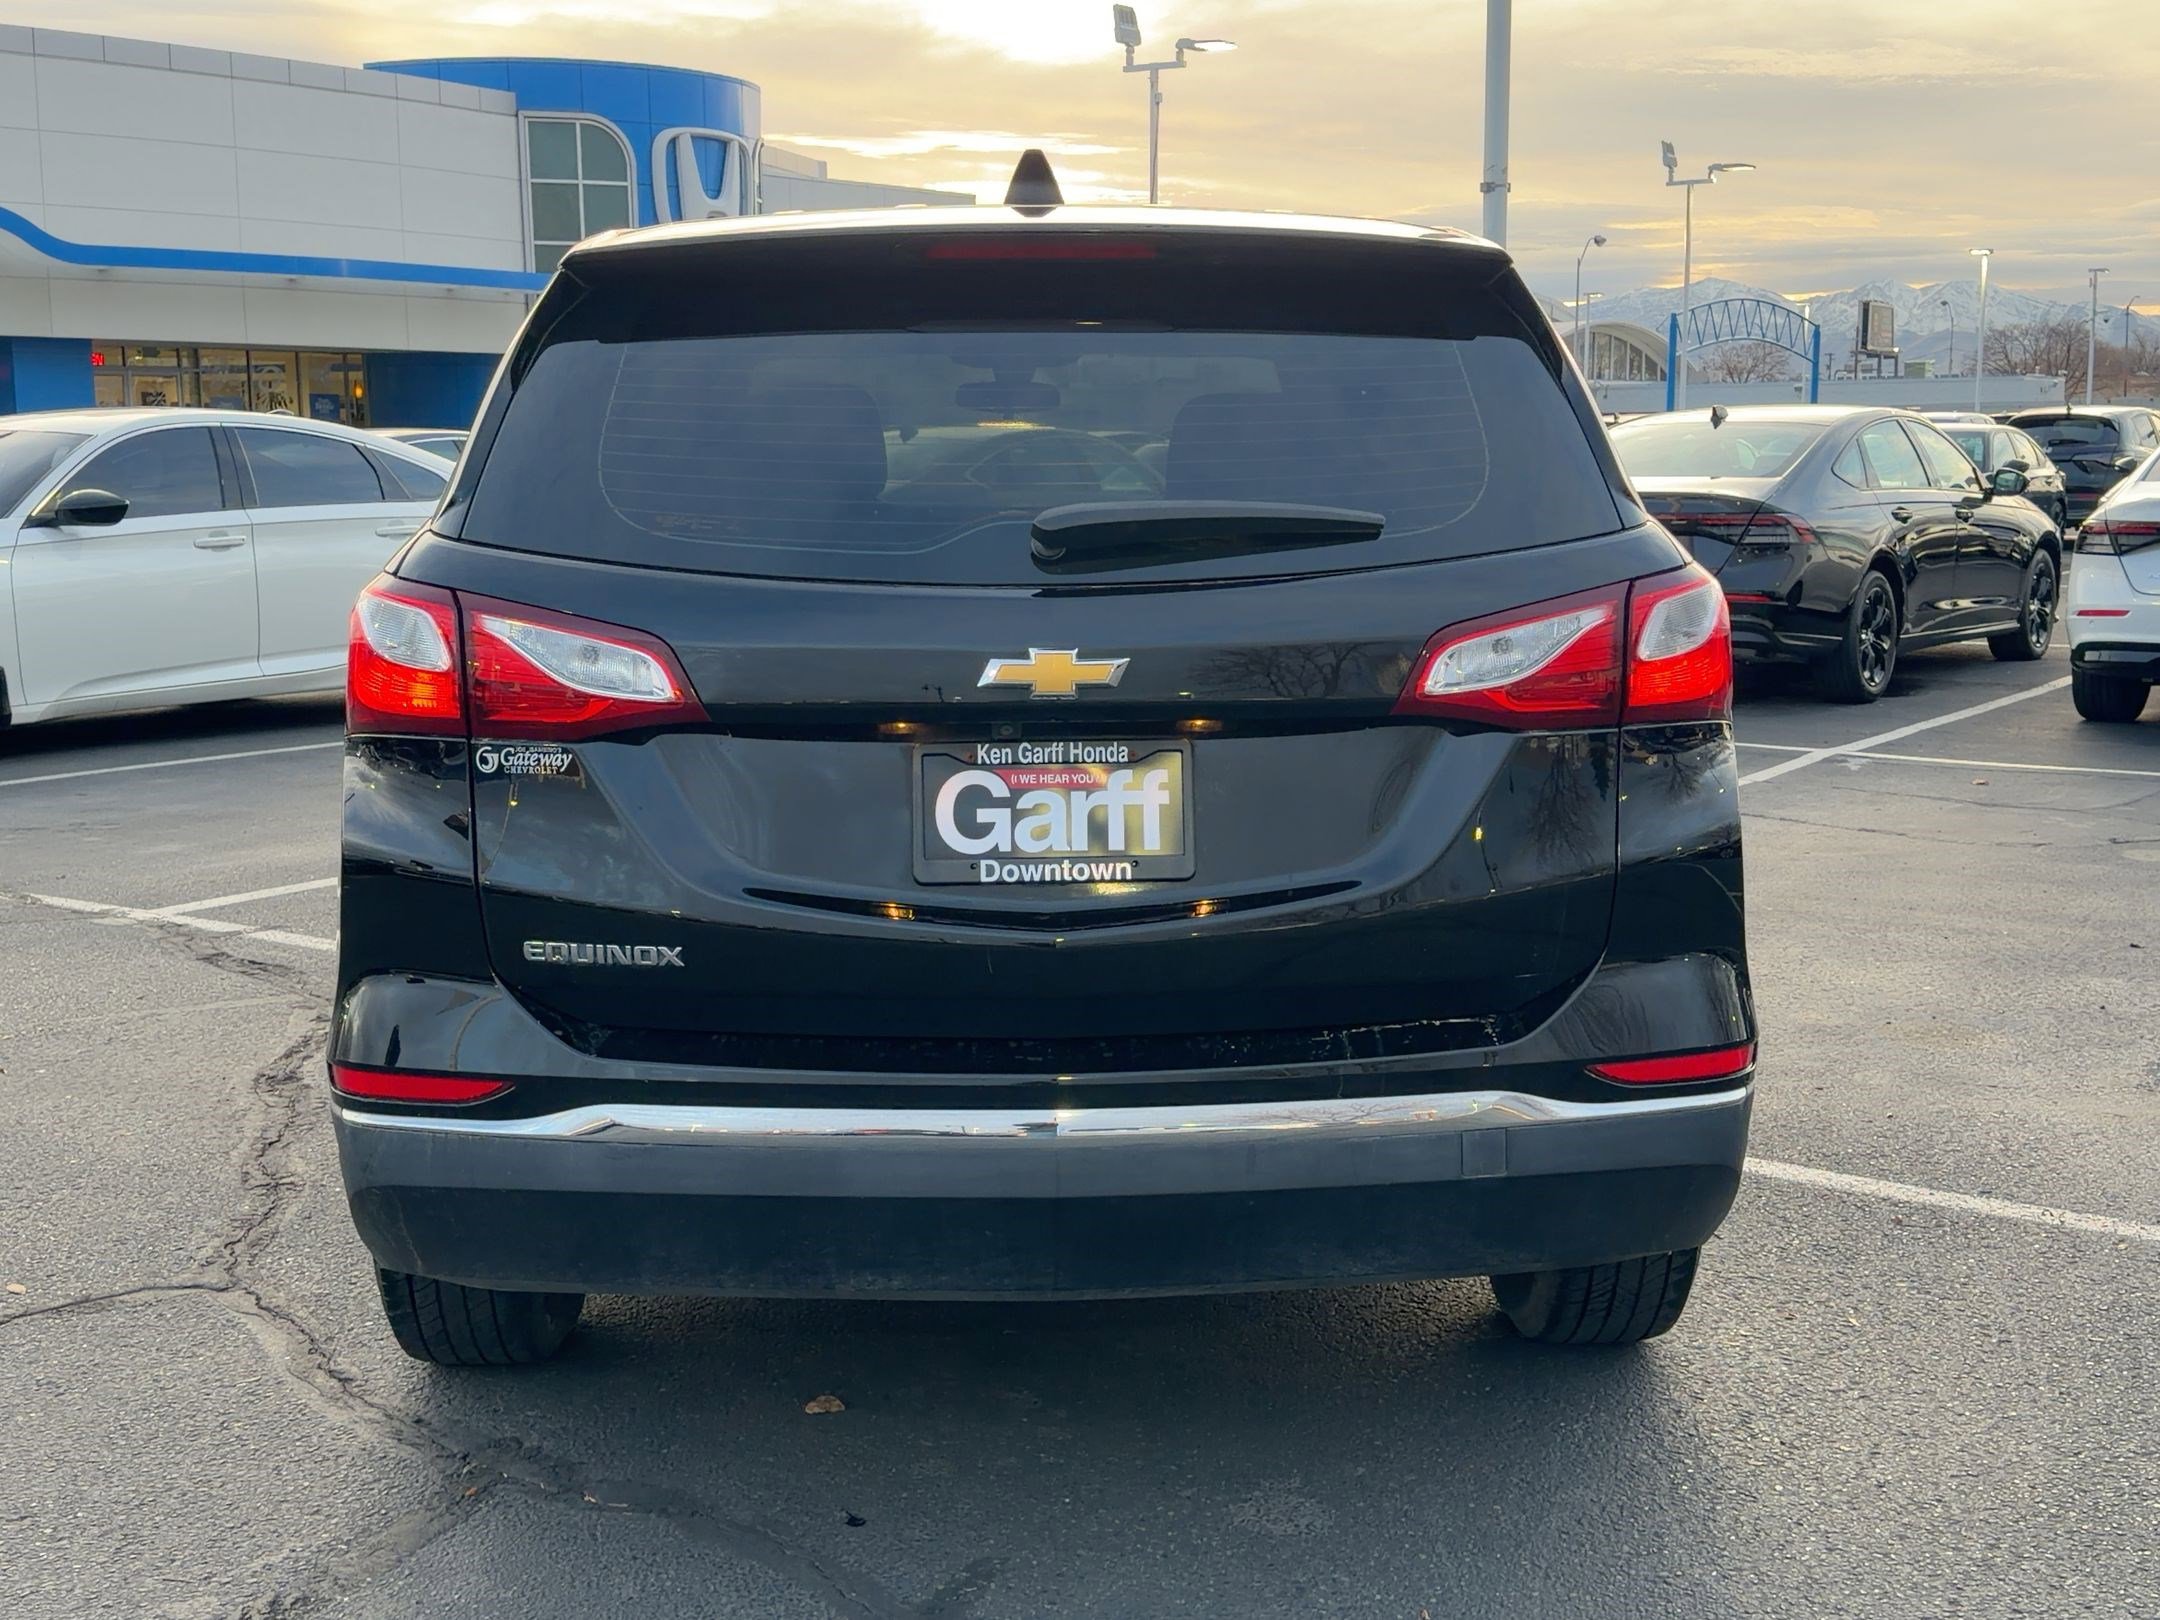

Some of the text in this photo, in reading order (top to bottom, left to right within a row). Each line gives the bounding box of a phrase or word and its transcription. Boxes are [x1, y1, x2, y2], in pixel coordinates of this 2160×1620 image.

[500, 747, 572, 772] Gateway
[977, 741, 1129, 765] Ken Garff Honda
[504, 766, 558, 774] CHEVROLET
[1019, 774, 1093, 784] WE HEAR YOU
[935, 769, 1170, 855] Garff
[980, 859, 1132, 883] Downtown
[523, 941, 685, 967] EQUINOX
